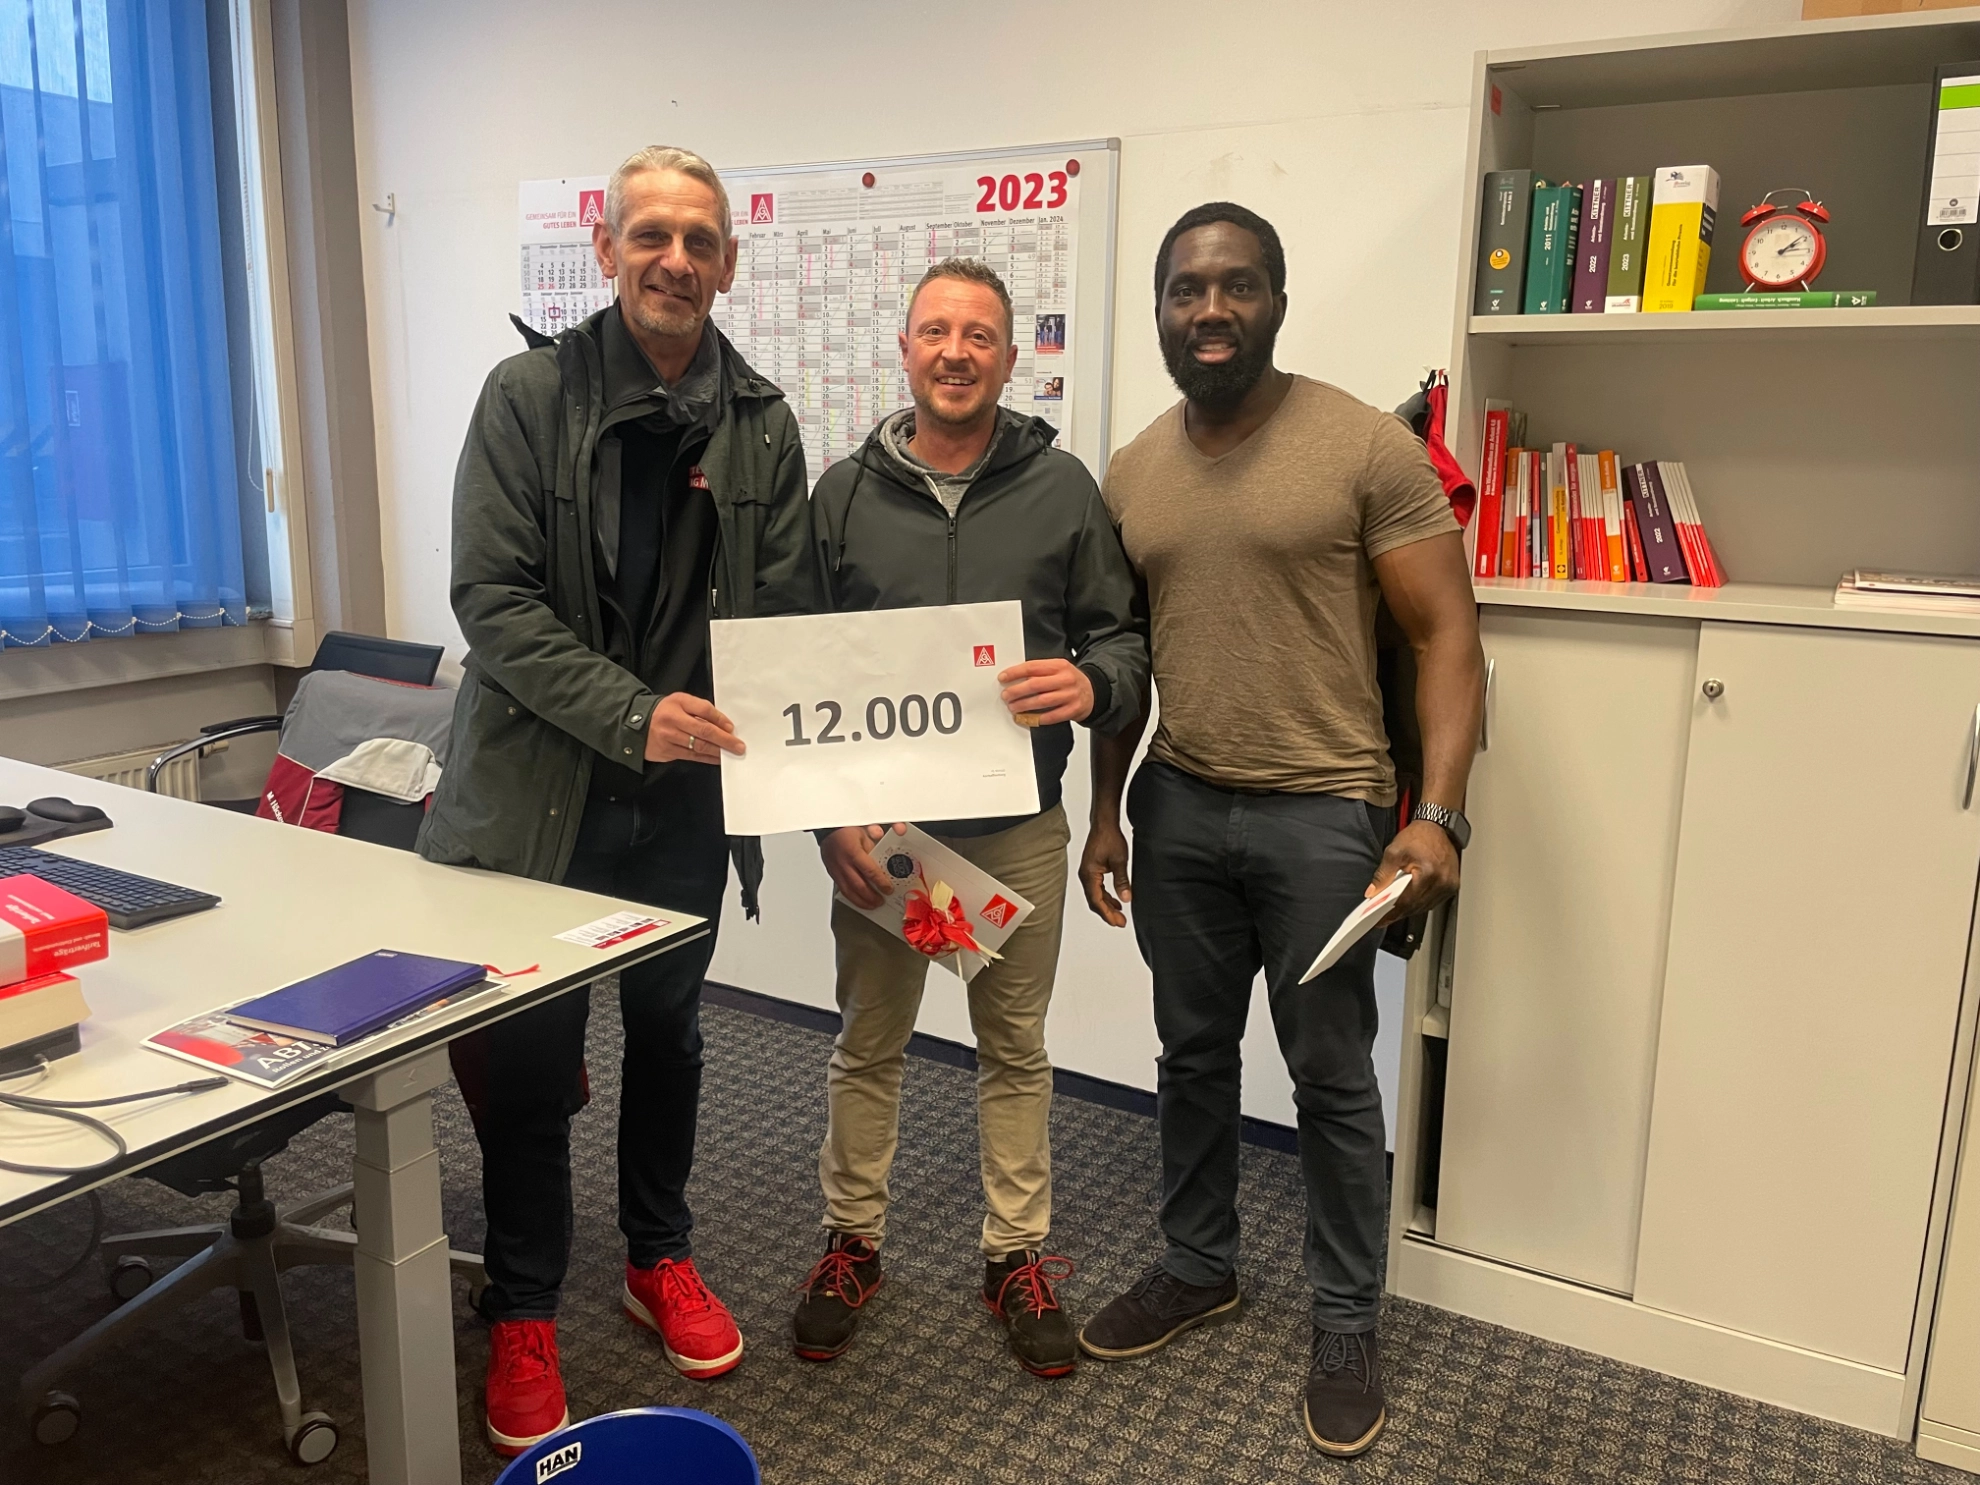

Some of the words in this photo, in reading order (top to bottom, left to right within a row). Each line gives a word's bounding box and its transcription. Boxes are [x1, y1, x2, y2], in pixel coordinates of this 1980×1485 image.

[976, 170, 1068, 212] 2023
[1624, 184, 1632, 216] KITTNER
[1638, 470, 1648, 497] KITTNER
[1654, 528, 1663, 543] 2022
[782, 691, 963, 747] 12.000
[54, 941, 101, 957] Tarifverträge
[257, 1041, 320, 1070] ABT
[303, 1050, 321, 1059] und
[538, 1446, 578, 1476] HAN
